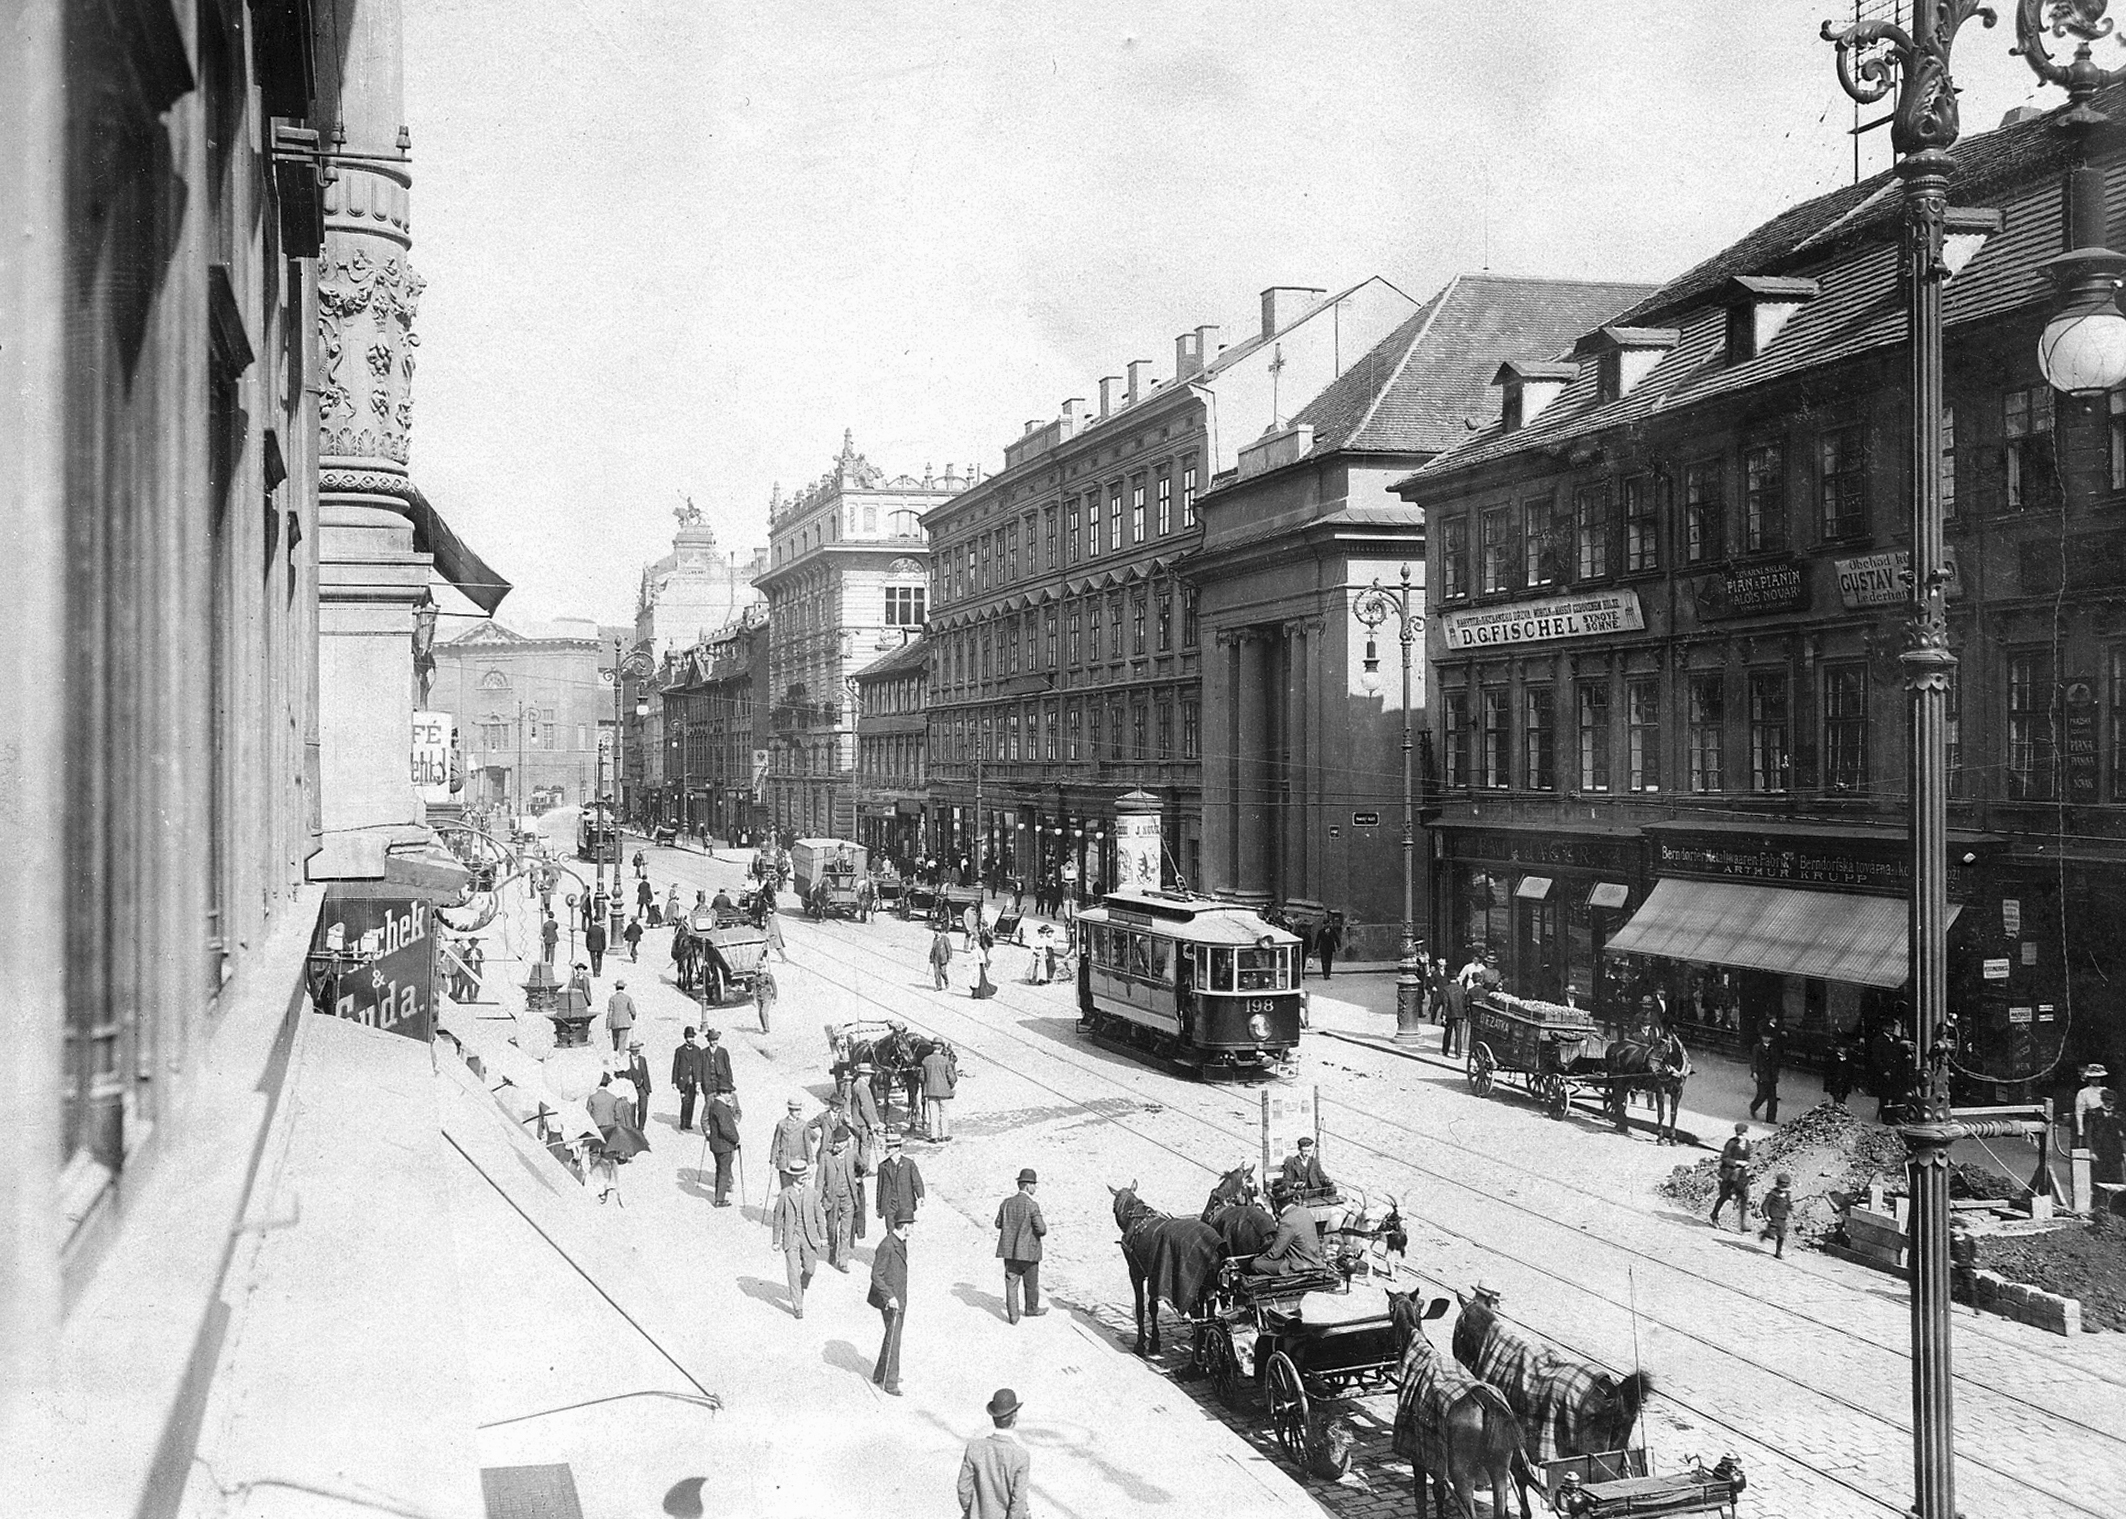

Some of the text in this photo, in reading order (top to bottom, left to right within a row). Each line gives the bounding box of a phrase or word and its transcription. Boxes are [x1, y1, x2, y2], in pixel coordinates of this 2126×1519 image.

[1840, 568, 1893, 592] GUSTAV
[412, 720, 441, 744] FÉ
[1723, 865, 1868, 884] ARTHUR KRUPP
[372, 969, 386, 989] &
[1245, 998, 1274, 1013] 198
